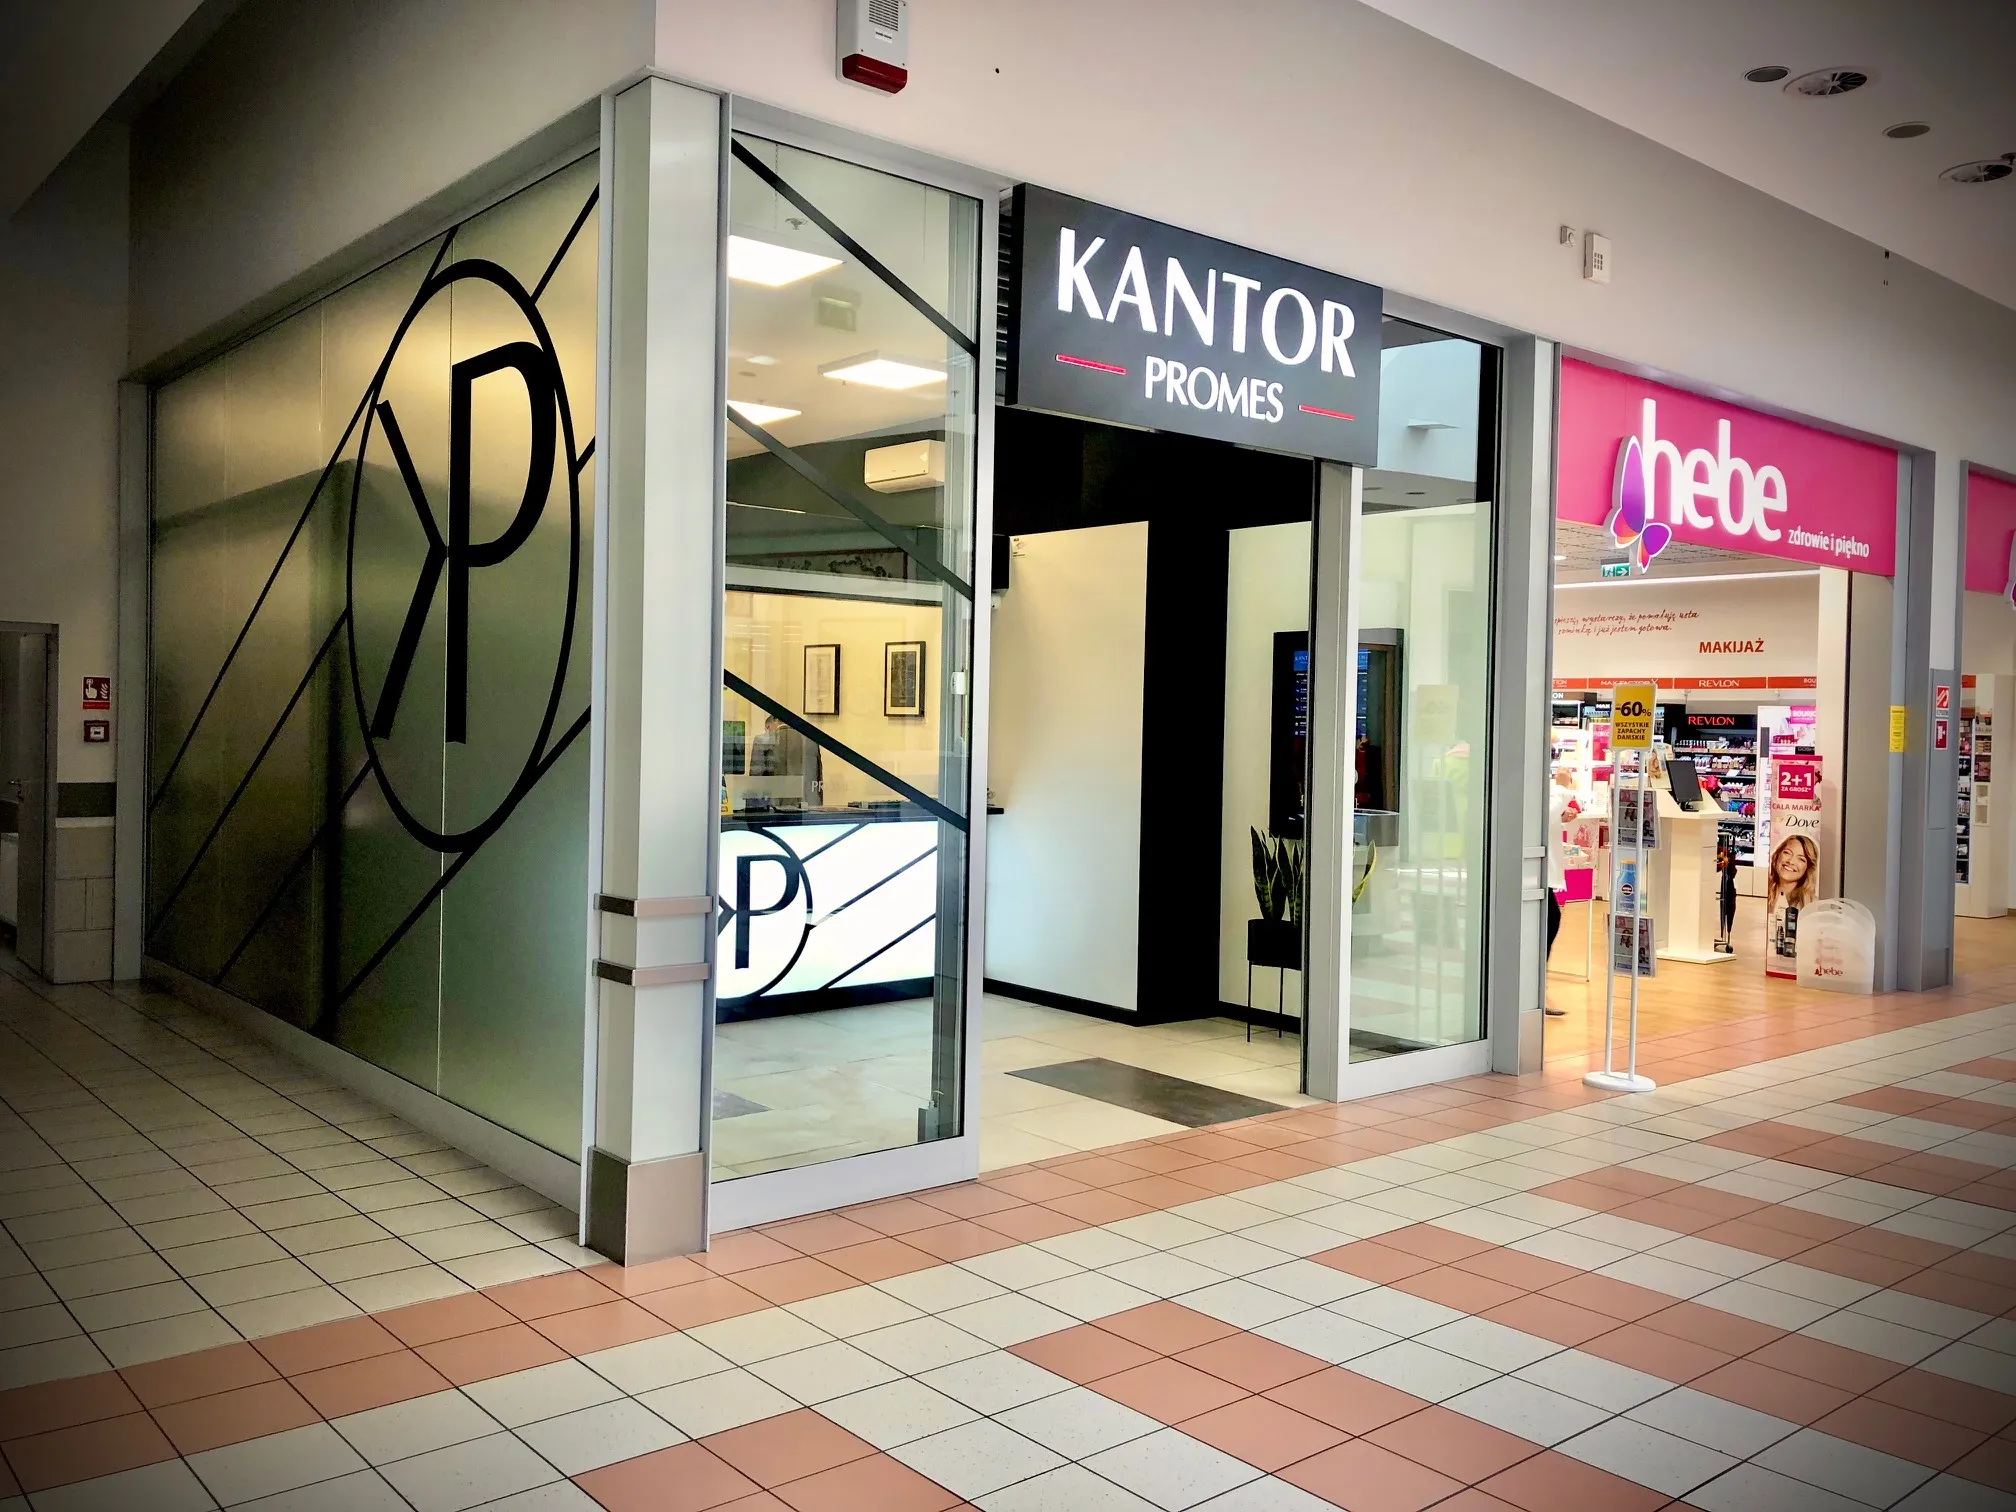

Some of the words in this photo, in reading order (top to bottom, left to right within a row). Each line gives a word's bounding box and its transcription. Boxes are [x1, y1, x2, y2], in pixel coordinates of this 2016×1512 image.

[1057, 226, 1356, 378] KANTOR
[1144, 355, 1284, 423] PROMES
[1642, 398, 1788, 542] hebe
[1788, 525, 1829, 551] zdrowie
[1830, 533, 1835, 551] i
[1835, 535, 1870, 559] piękno
[1637, 608, 1676, 623] pomaluję
[1679, 609, 1700, 619] usta
[1610, 624, 1637, 636] jestem
[1638, 622, 1673, 635] gotowa.
[1699, 637, 1765, 654] MAKIJAŻ
[1698, 679, 1741, 687] REVLON
[1615, 701, 1652, 717] -60%
[1688, 716, 1735, 726] REVLON
[1780, 771, 1812, 787] 2+1
[1791, 804, 1821, 812] MARKA
[1785, 813, 1820, 828] Dove
[1819, 965, 1844, 977] hebe
